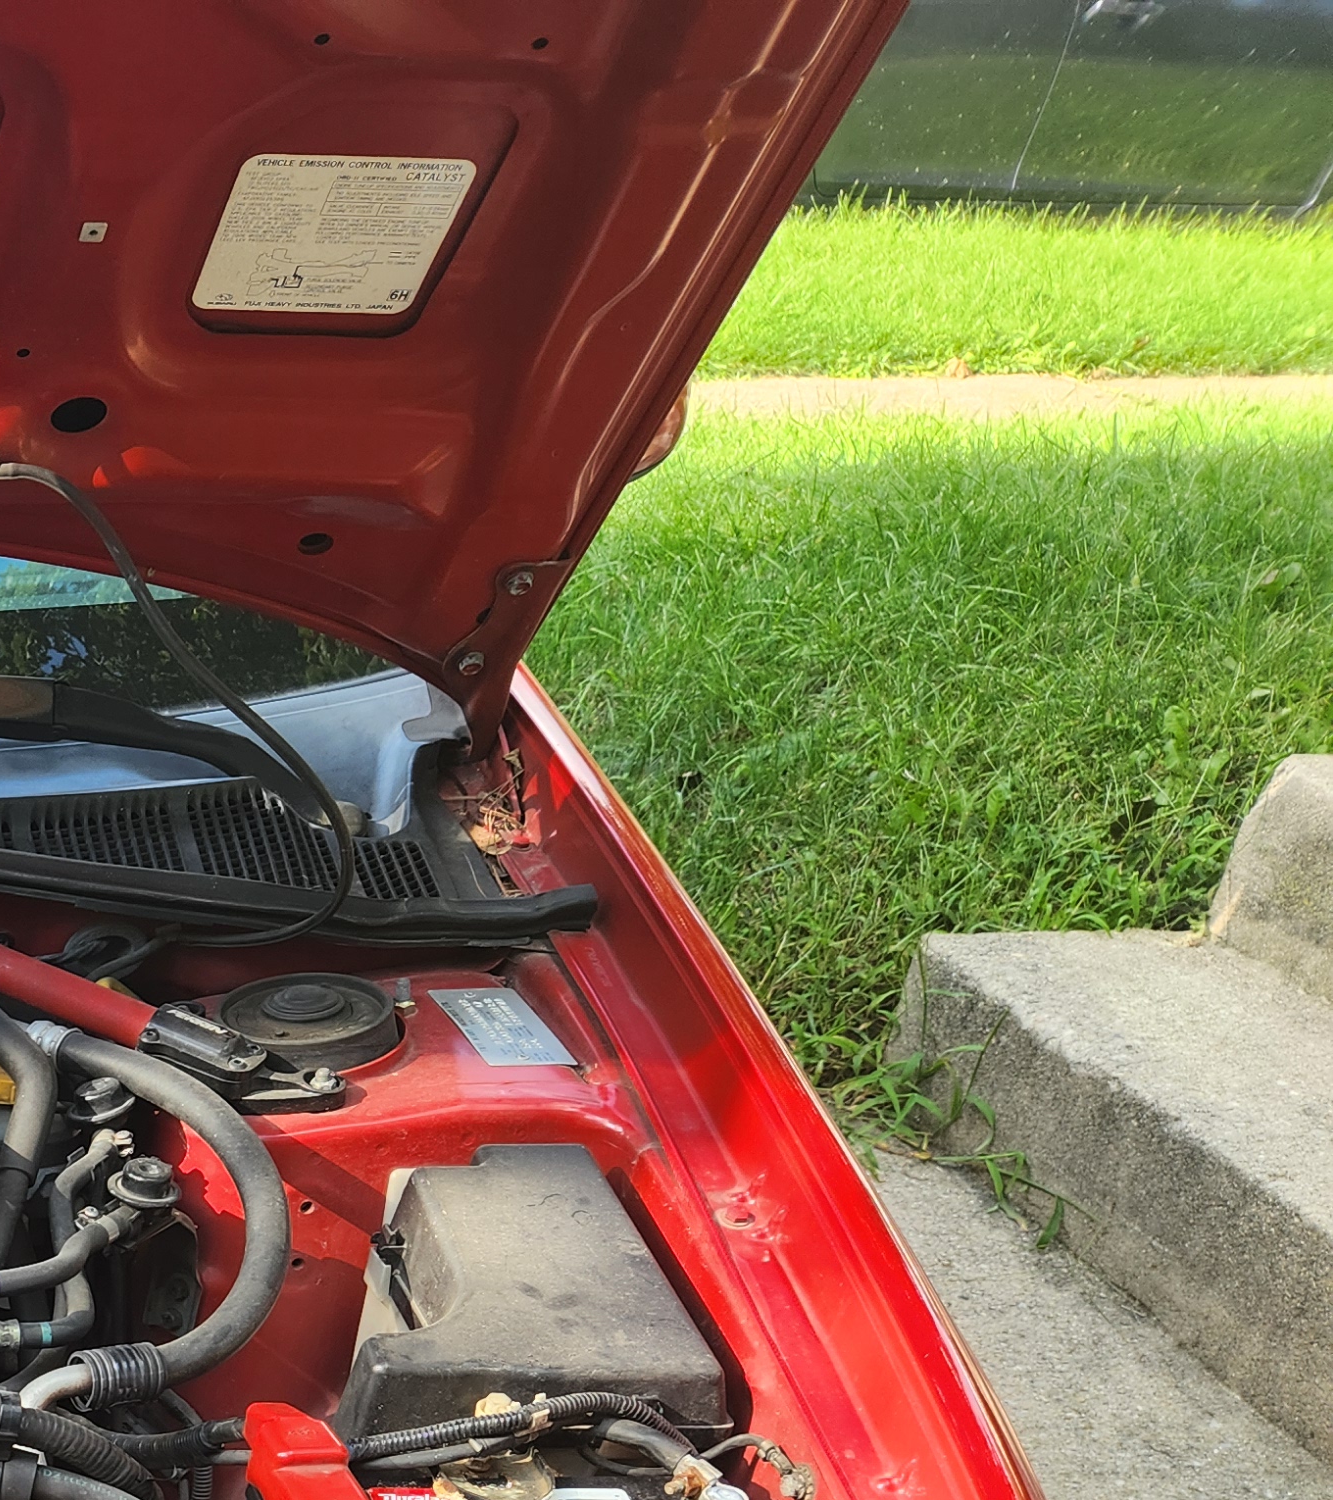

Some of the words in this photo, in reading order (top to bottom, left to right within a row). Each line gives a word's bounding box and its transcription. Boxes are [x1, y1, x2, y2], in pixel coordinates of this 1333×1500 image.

[257, 158, 295, 167] VEHICLE
[299, 160, 345, 169] EMISSION
[349, 161, 393, 170] CONTROL
[397, 162, 463, 172] INFORMATION
[406, 172, 467, 182] CATALYST
[389, 290, 410, 301] 6H
